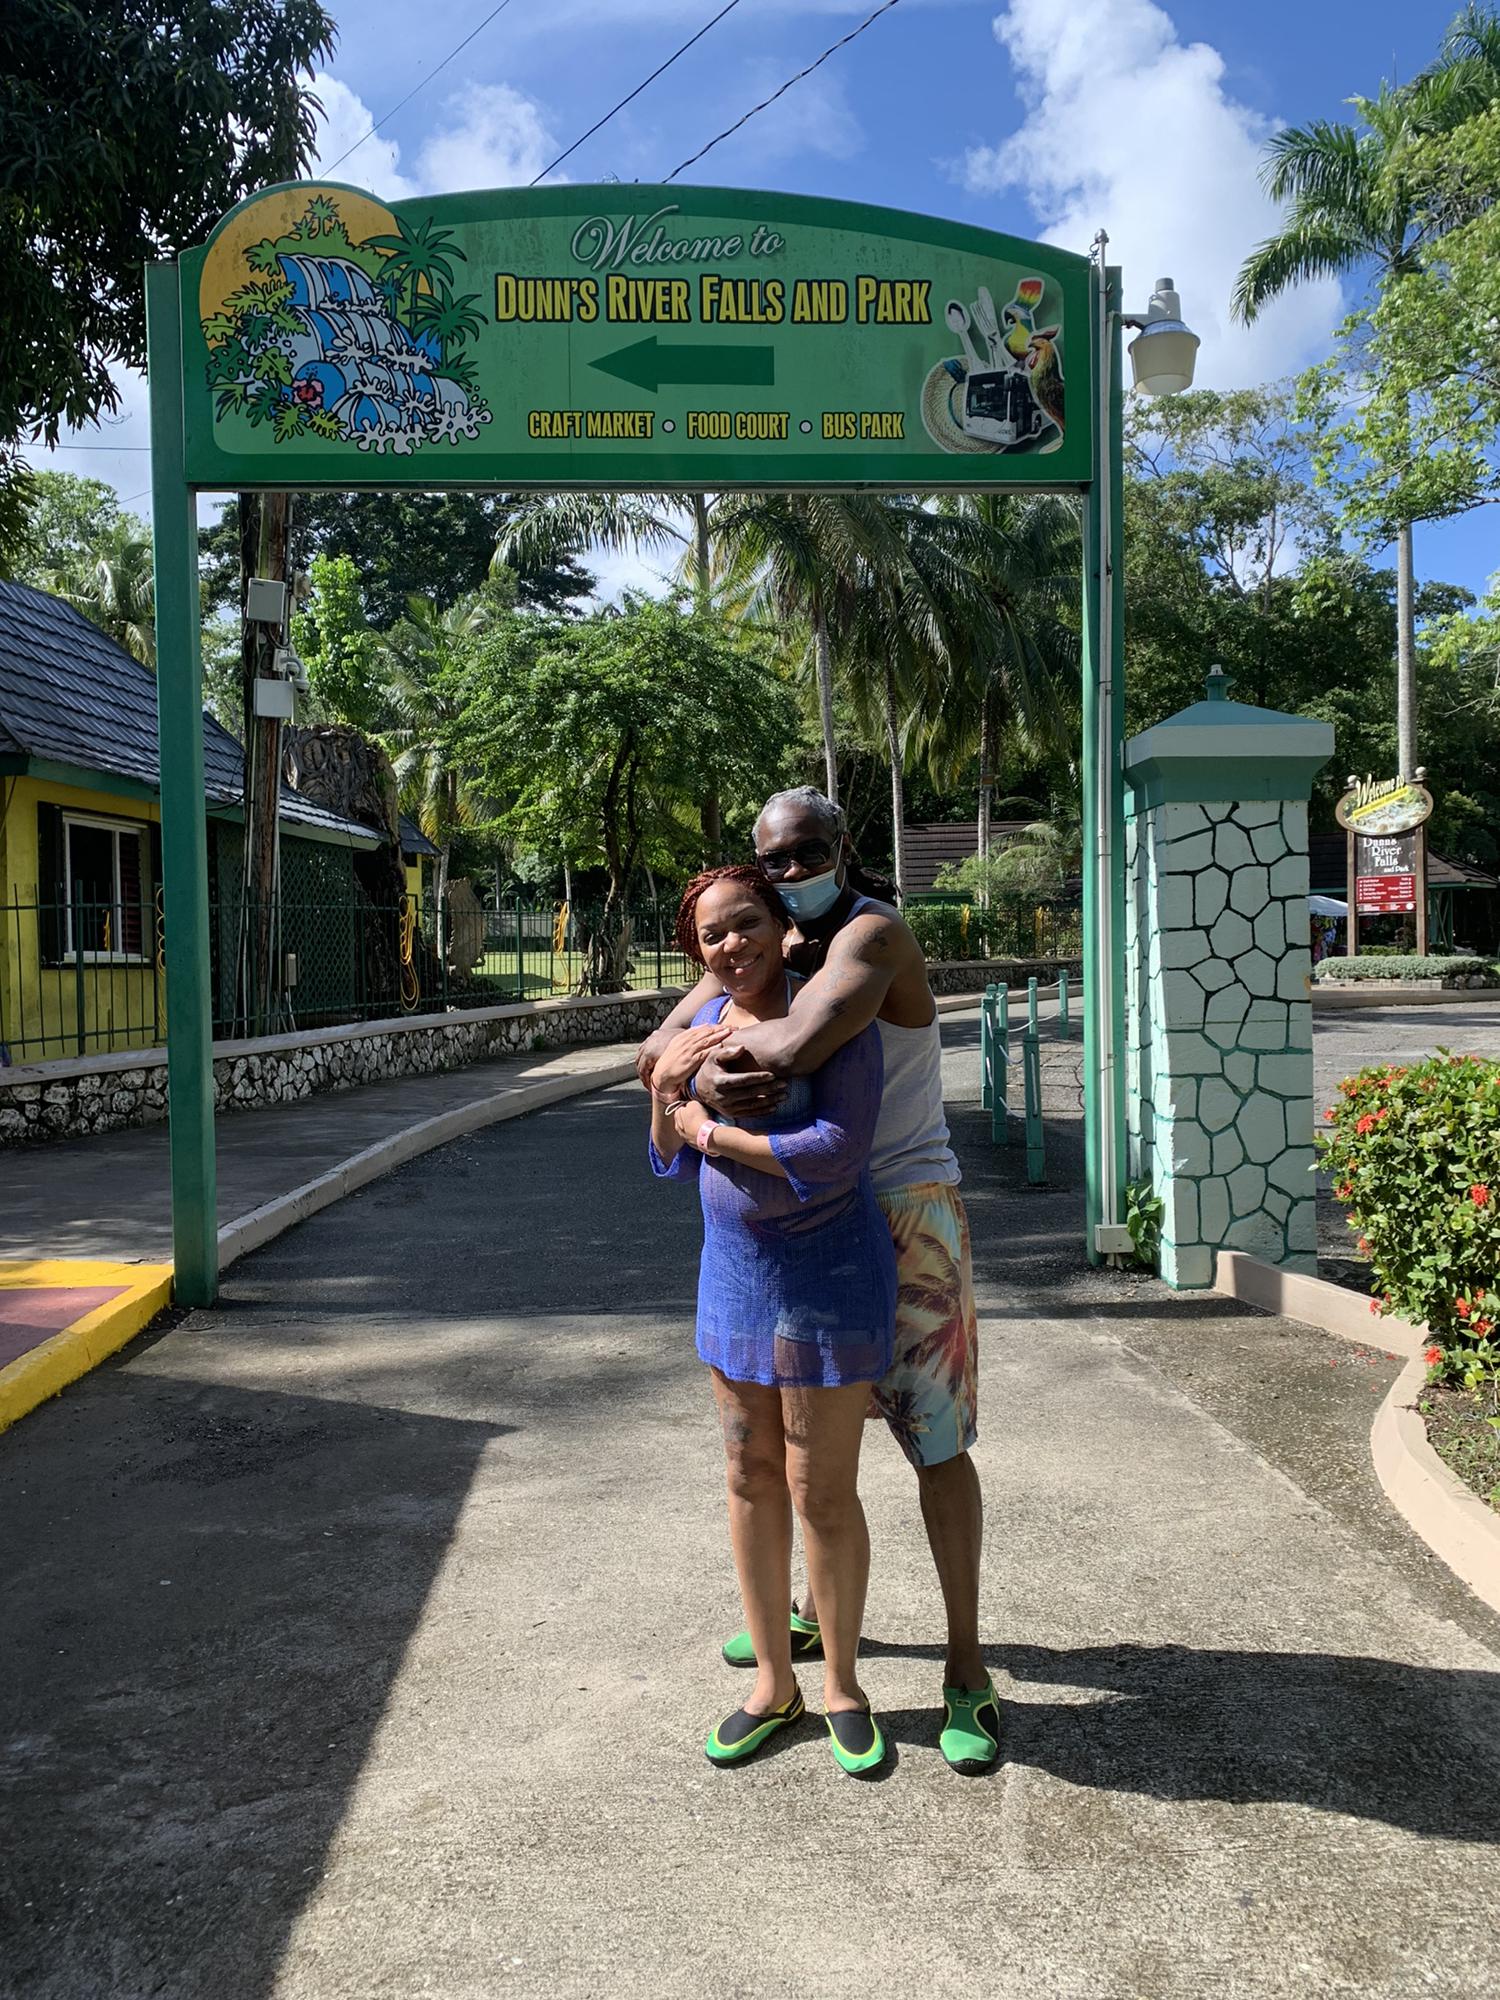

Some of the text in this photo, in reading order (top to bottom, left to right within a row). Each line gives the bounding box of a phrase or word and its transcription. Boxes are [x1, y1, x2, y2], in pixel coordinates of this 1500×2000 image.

[571, 204, 785, 270] Welcome to
[605, 273, 692, 323] RIVER
[700, 274, 785, 324] FALLS
[791, 279, 849, 324] AND
[855, 275, 932, 325] PARK
[528, 411, 655, 438] CRAFT MARKET
[686, 411, 790, 439] FOOD COURT
[821, 412, 905, 439] BUS PARK
[1355, 773, 1395, 808] Welcome
[1371, 846, 1402, 857] River
[1374, 855, 1399, 867] Falls
